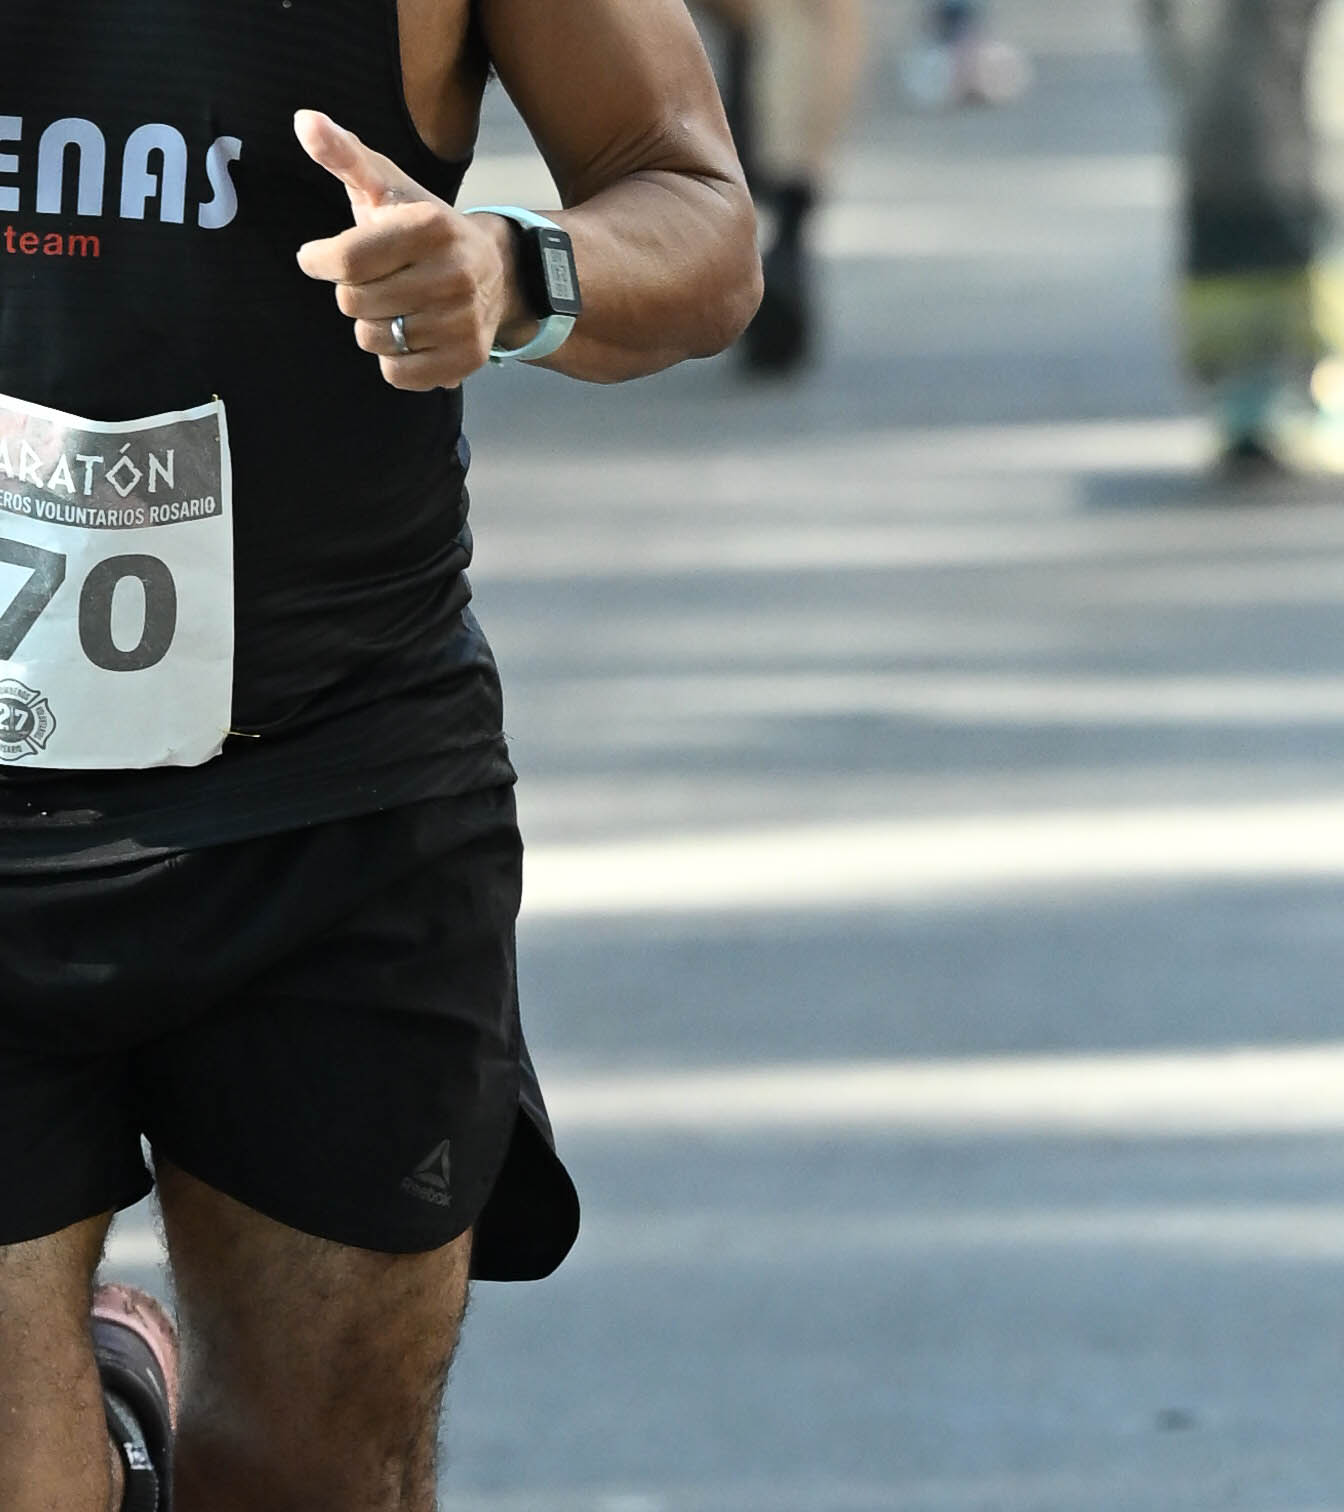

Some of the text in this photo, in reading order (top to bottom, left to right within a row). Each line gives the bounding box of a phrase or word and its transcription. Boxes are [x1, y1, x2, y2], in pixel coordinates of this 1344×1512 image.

[5, 224, 101, 258] team
[35, 499, 145, 527] VOLUNTARIOS
[149, 495, 216, 524] ROSARIO
